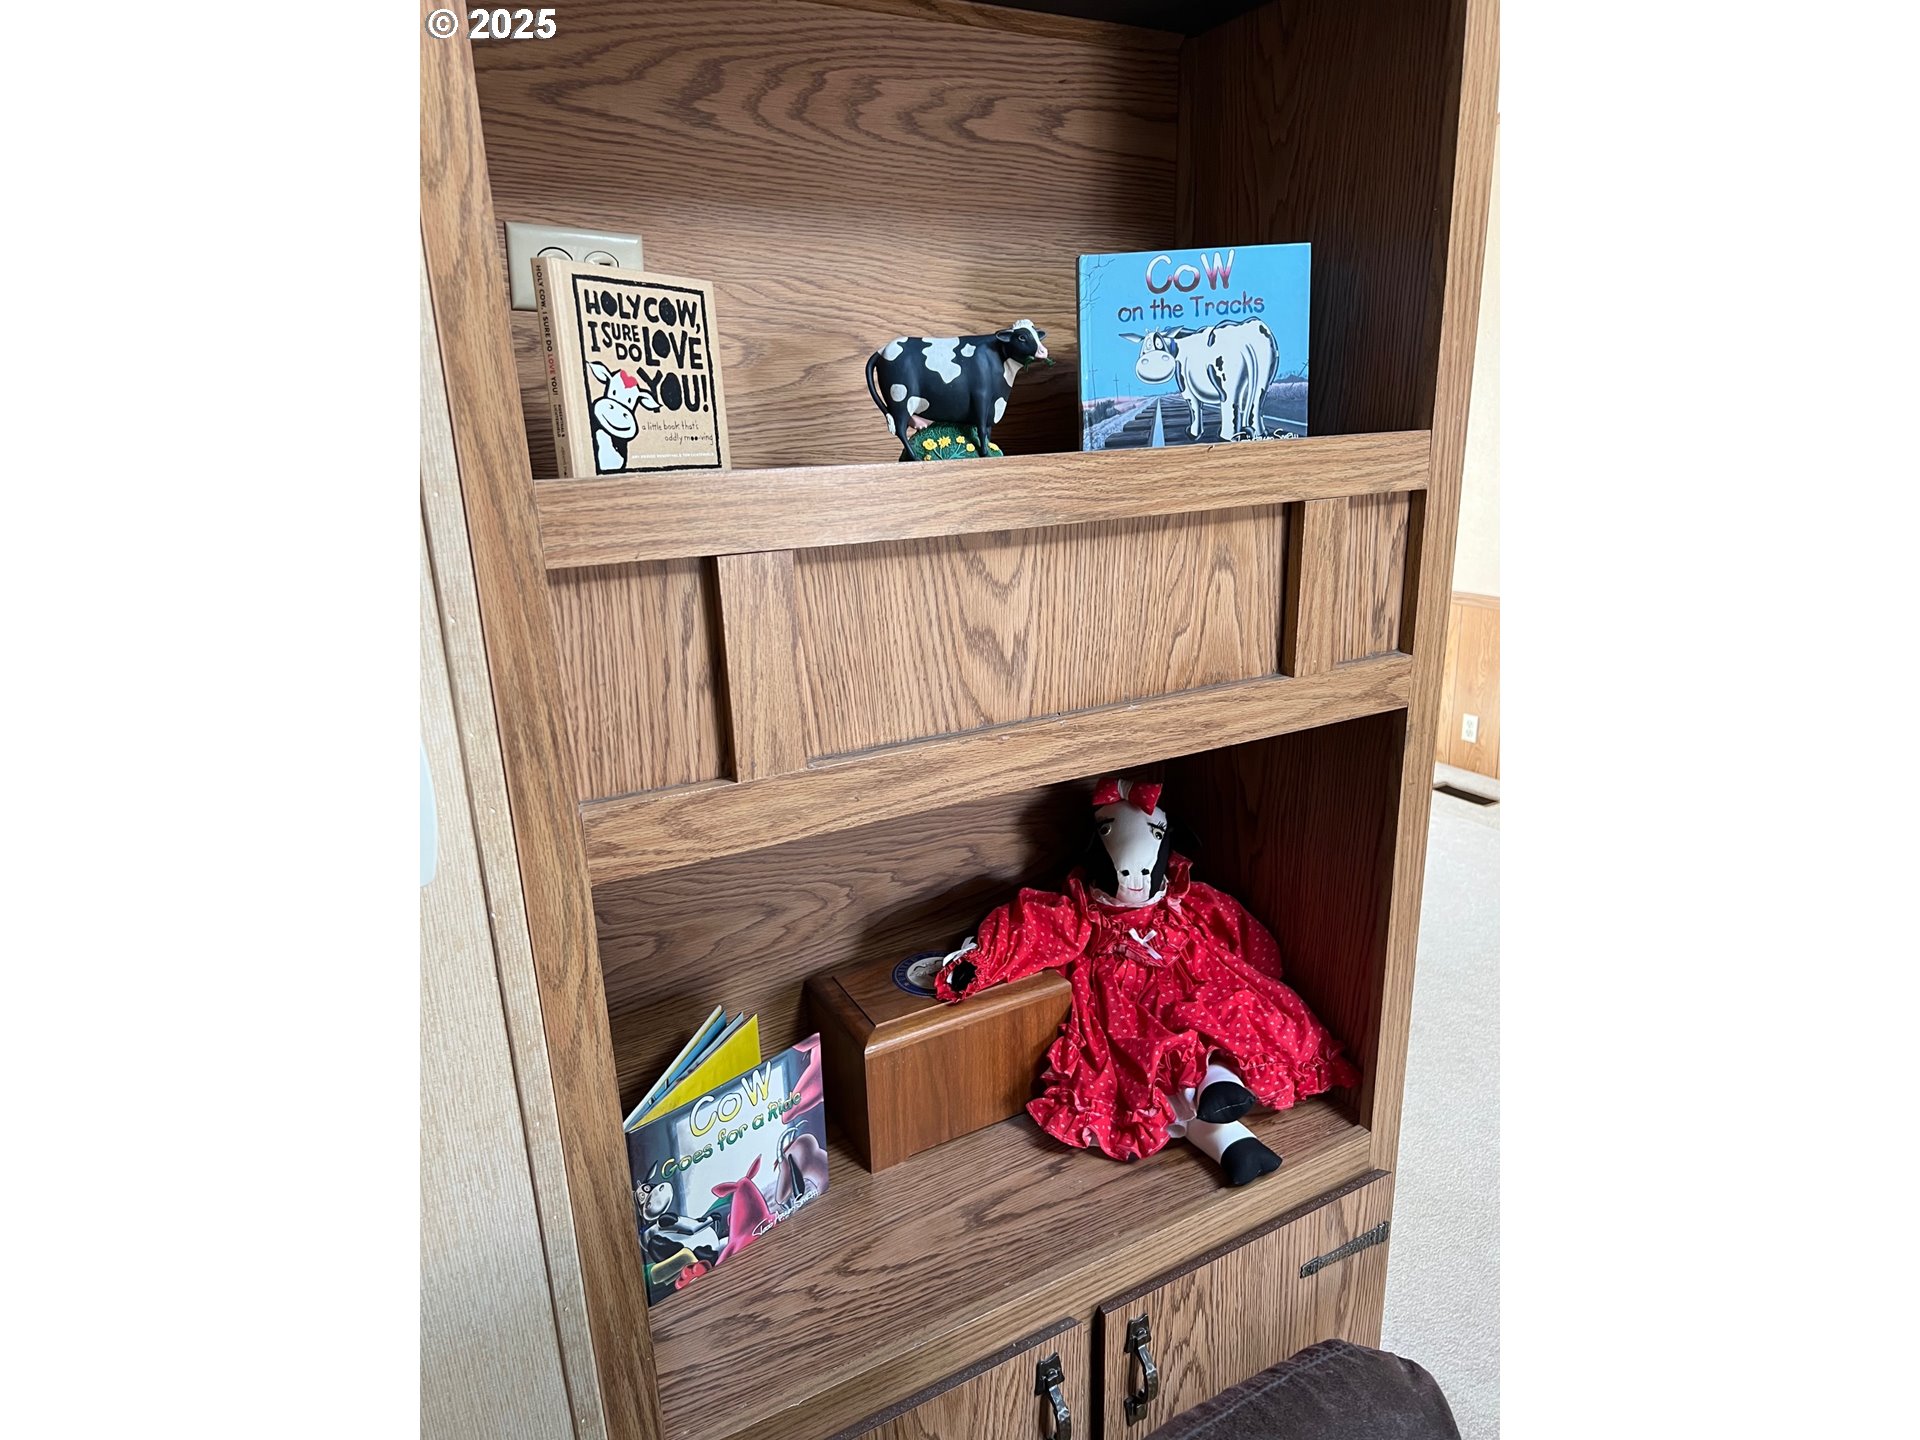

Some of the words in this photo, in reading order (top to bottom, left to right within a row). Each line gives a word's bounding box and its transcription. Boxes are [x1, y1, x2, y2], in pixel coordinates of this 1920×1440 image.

[536, 265, 544, 287] HOLY
[584, 289, 641, 320] HOLY
[644, 297, 701, 334] COW,
[1118, 305, 1143, 323] on
[1150, 298, 1184, 320] the
[1189, 291, 1266, 317] Tracks
[543, 316, 551, 337] SURE
[588, 321, 600, 352] I
[601, 322, 641, 348] SURE
[546, 340, 553, 352] DO
[615, 343, 642, 362] DO
[642, 326, 704, 369] LOVE
[548, 353, 556, 375] LOVE
[551, 376, 559, 396] YOU!
[636, 367, 709, 413] YOU!
[647, 421, 662, 431] little
[663, 419, 679, 430] book
[681, 419, 699, 430] that's
[665, 432, 682, 445] oddly
[661, 1143, 714, 1180] Goes
[717, 1124, 749, 1151] for
[752, 1113, 765, 1130] a
[767, 1091, 802, 1122] Ride
